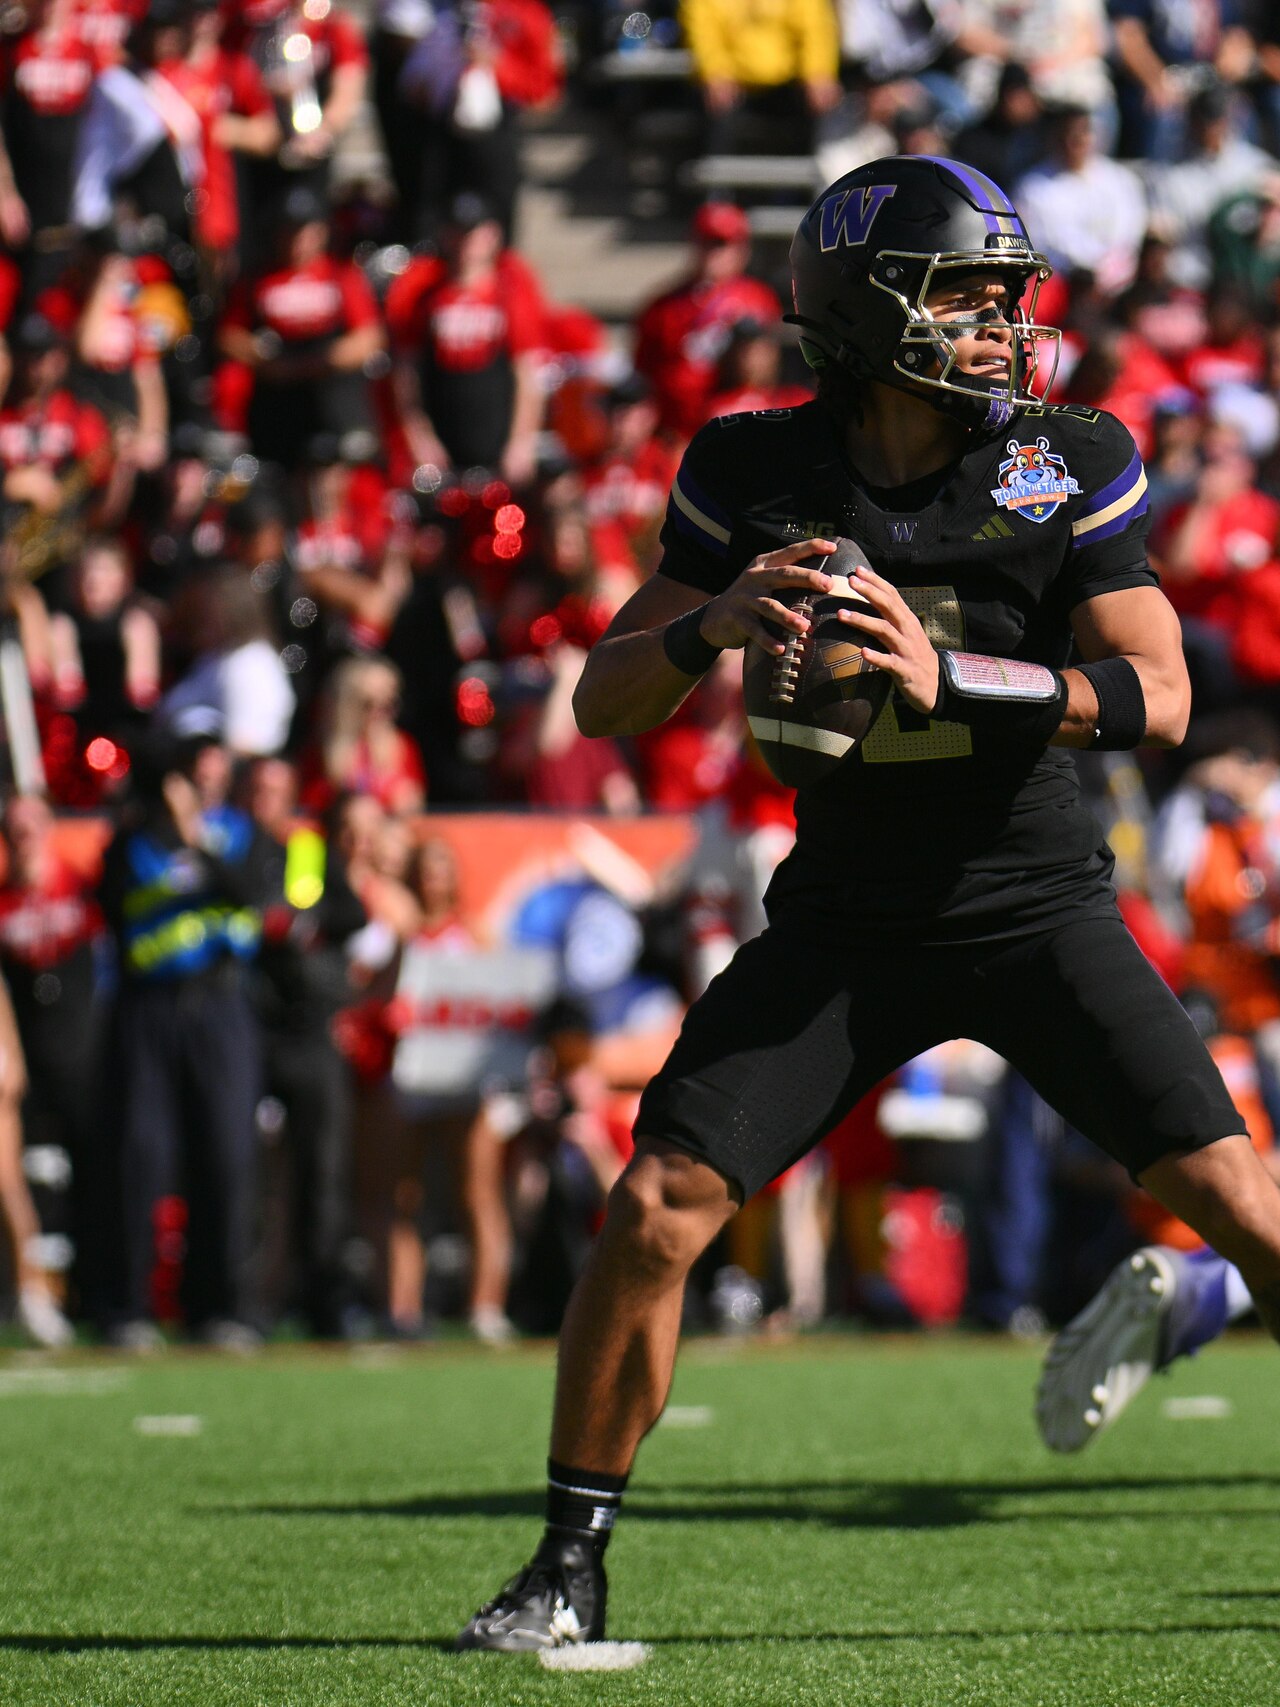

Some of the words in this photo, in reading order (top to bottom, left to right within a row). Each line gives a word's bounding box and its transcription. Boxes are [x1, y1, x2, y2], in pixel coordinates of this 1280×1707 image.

[819, 185, 898, 253] W
[994, 486, 1027, 503] TONY
[1042, 479, 1077, 493] TIGER
[886, 520, 919, 543] W
[861, 586, 973, 763] 2
